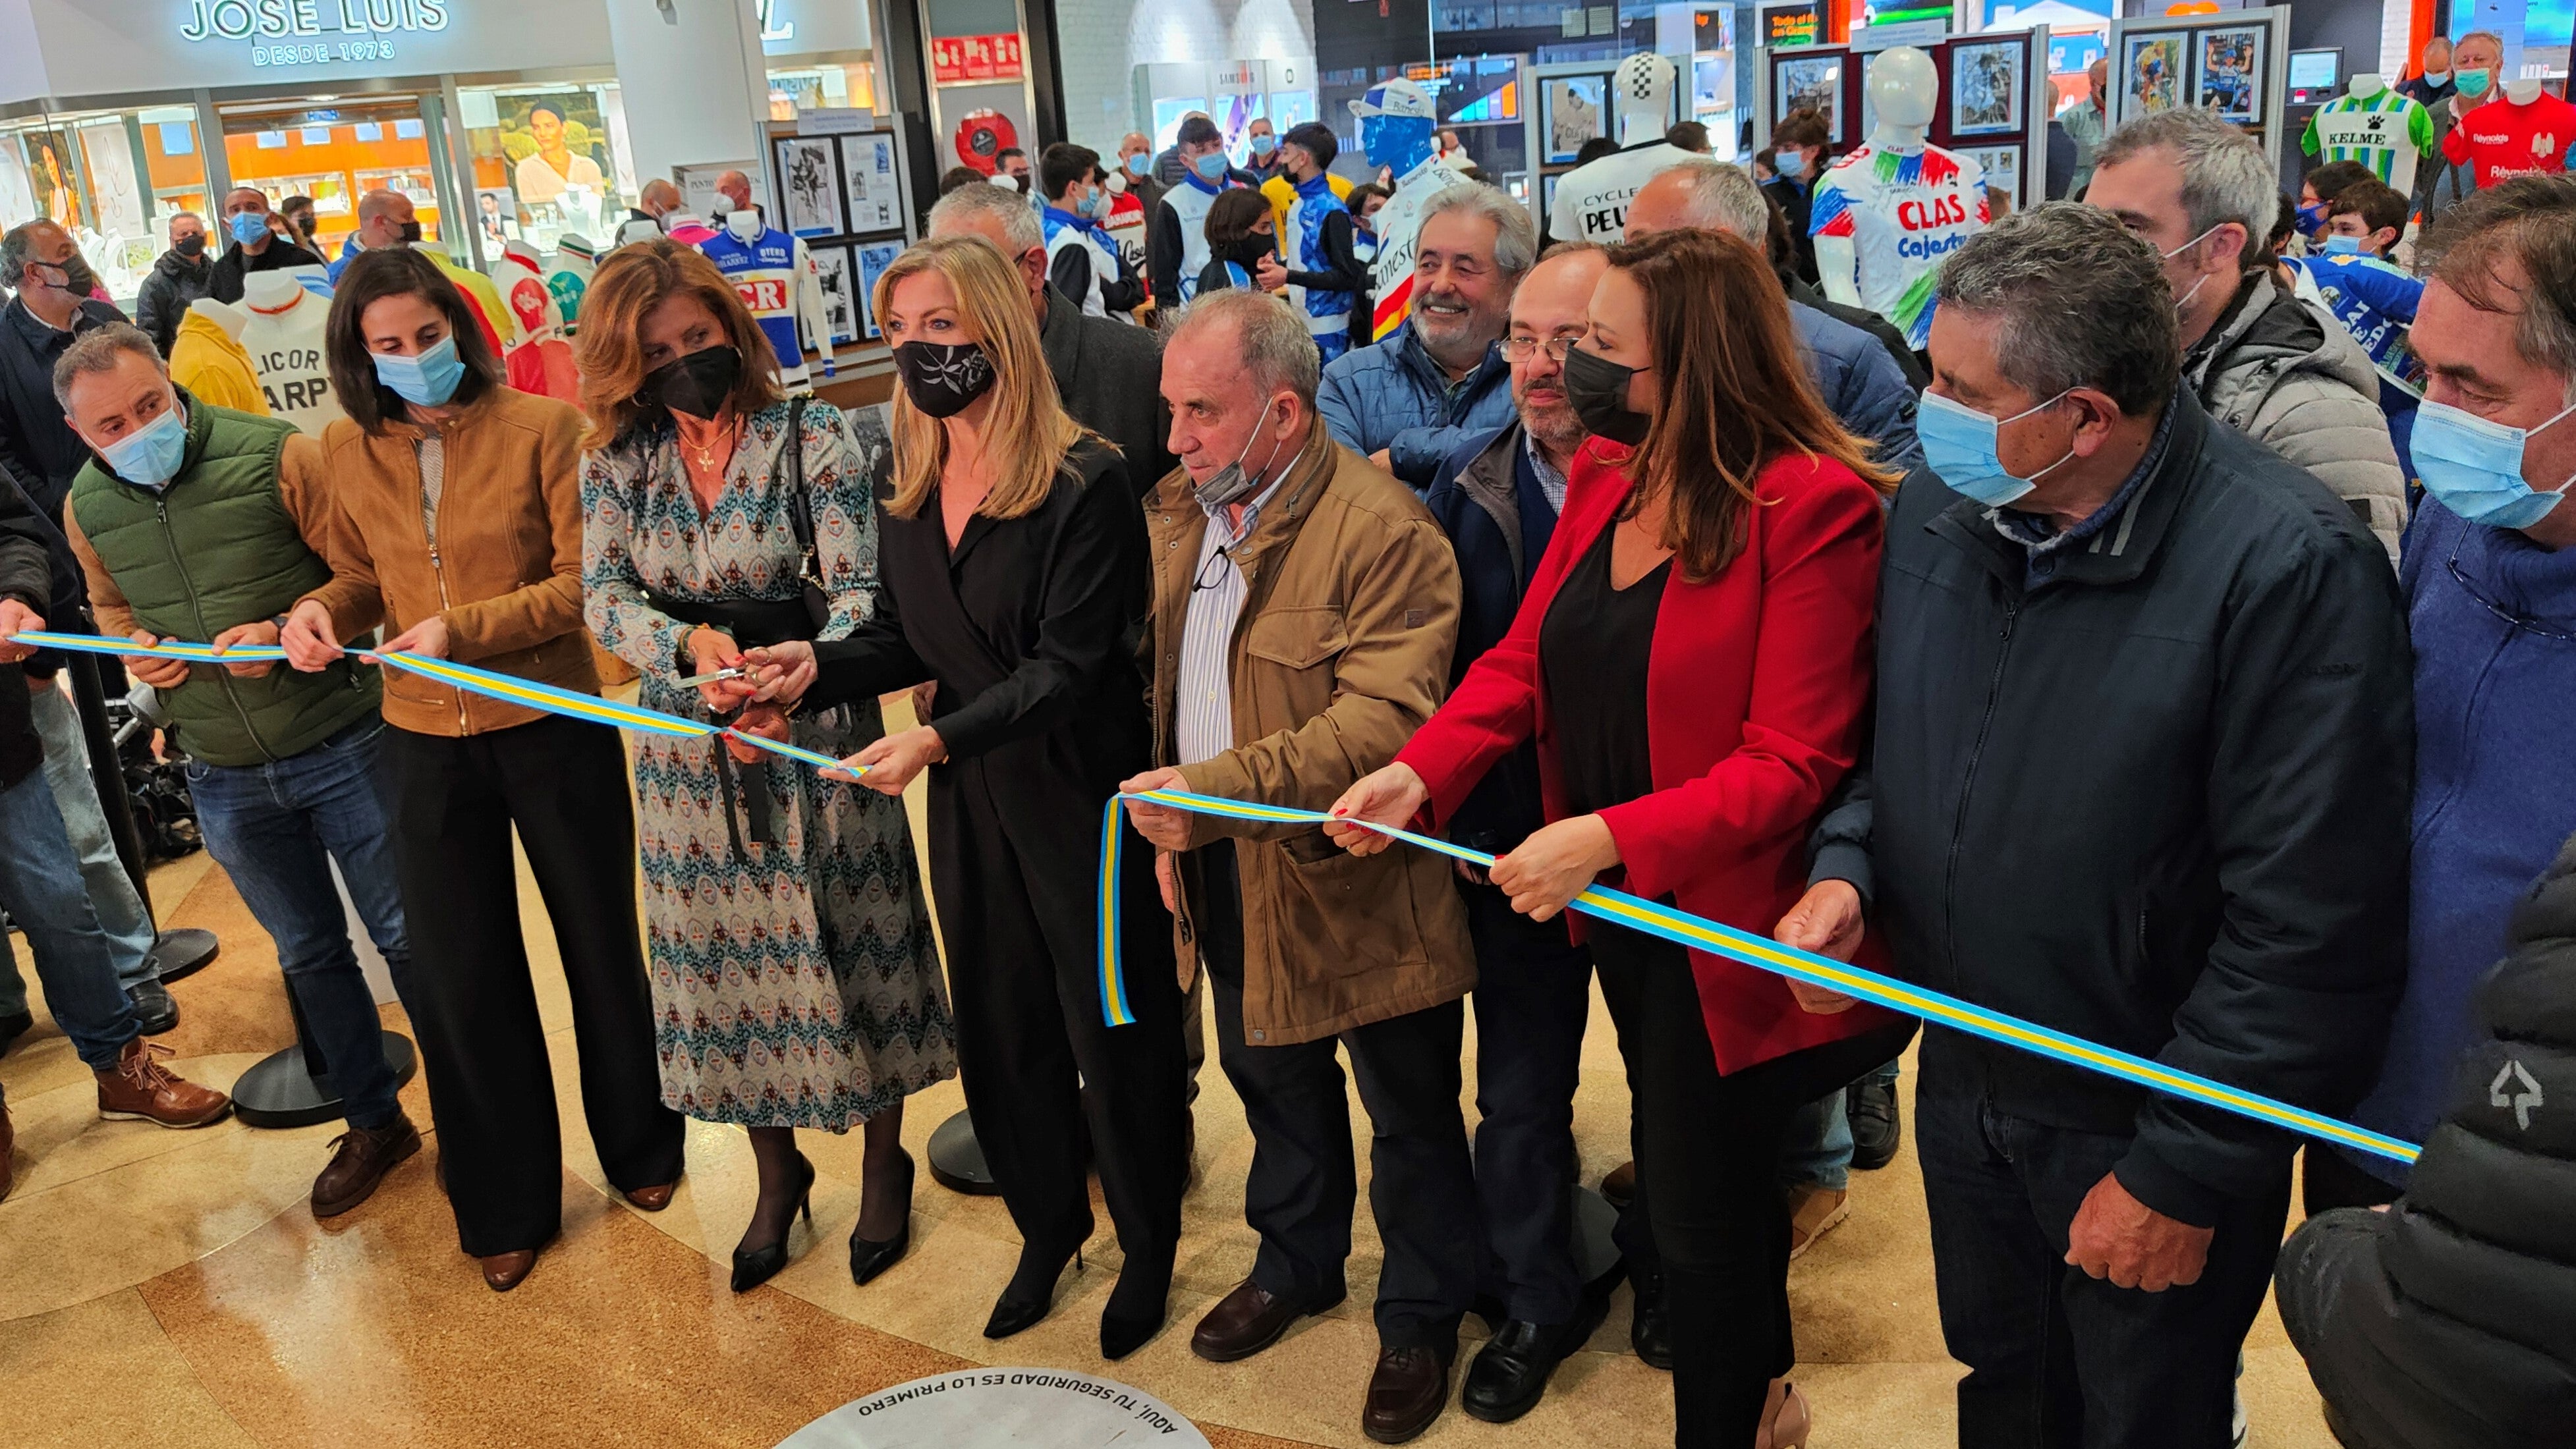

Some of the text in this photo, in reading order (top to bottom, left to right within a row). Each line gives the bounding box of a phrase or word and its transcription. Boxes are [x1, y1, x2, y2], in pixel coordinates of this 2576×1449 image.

[340, 0, 449, 34] LUIS
[252, 40, 395, 66] DESDE 1973
[1393, 101, 1424, 115] Banesto
[2329, 132, 2386, 145] KELME
[1897, 194, 1965, 231] CLAS
[858, 1373, 1178, 1434] AQUÍ, TU SEGURIDAD ES LO PRIMERO
